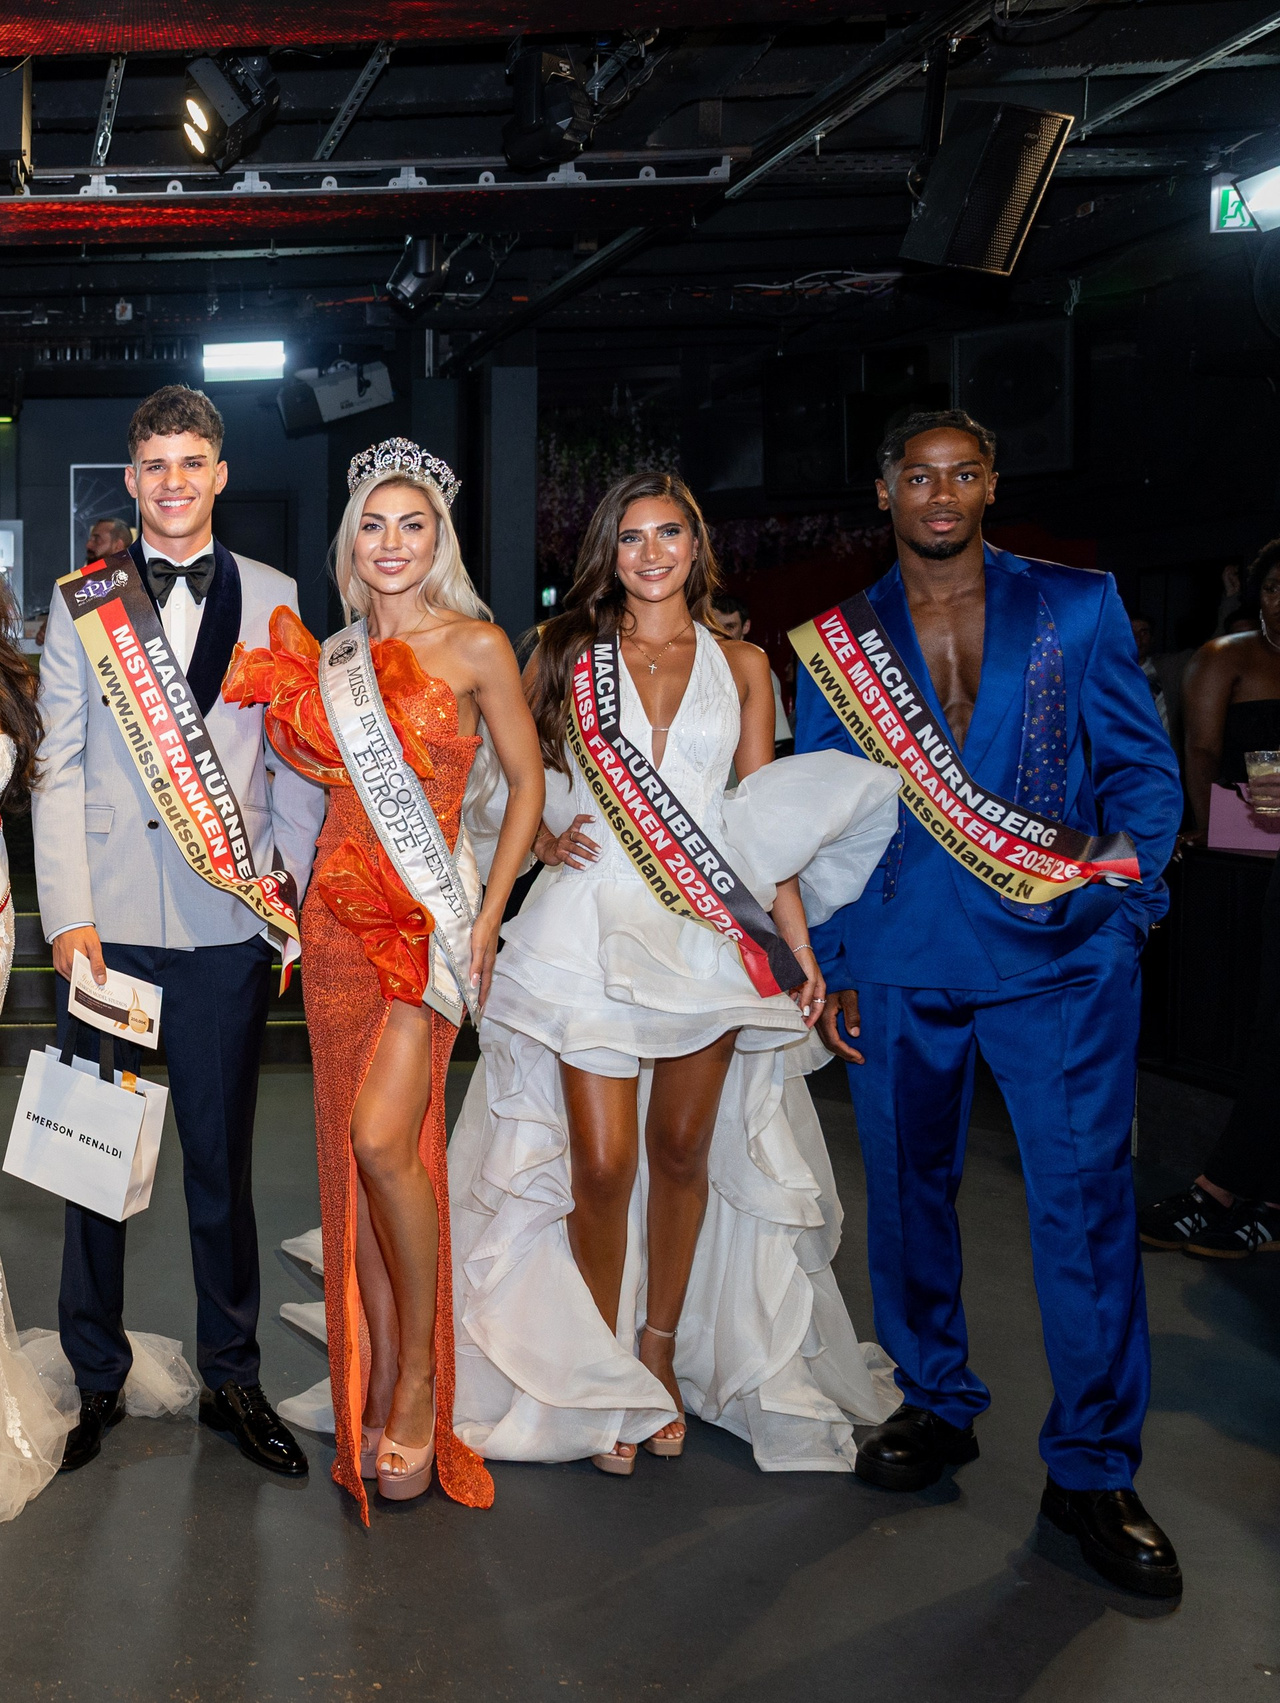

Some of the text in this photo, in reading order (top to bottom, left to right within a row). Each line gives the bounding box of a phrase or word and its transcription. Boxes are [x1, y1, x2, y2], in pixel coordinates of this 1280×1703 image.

[111, 623, 169, 726] MISTER
[158, 722, 229, 859] FRANKEN
[144, 636, 204, 742] MACH1
[346, 663, 463, 919] MISS INTERCONTINENTAL
[353, 747, 418, 854] EUROPE
[573, 670, 745, 942] MISS FRANKEN 2025/26
[594, 643, 736, 896] MACH1 NÜRNBERG
[820, 614, 1082, 882] VIZE MISTER FRANKEN 2025/26
[857, 628, 1058, 848] MACH1 NÜRNBERG
[26, 1110, 122, 1159] EMERSON RENALDI
